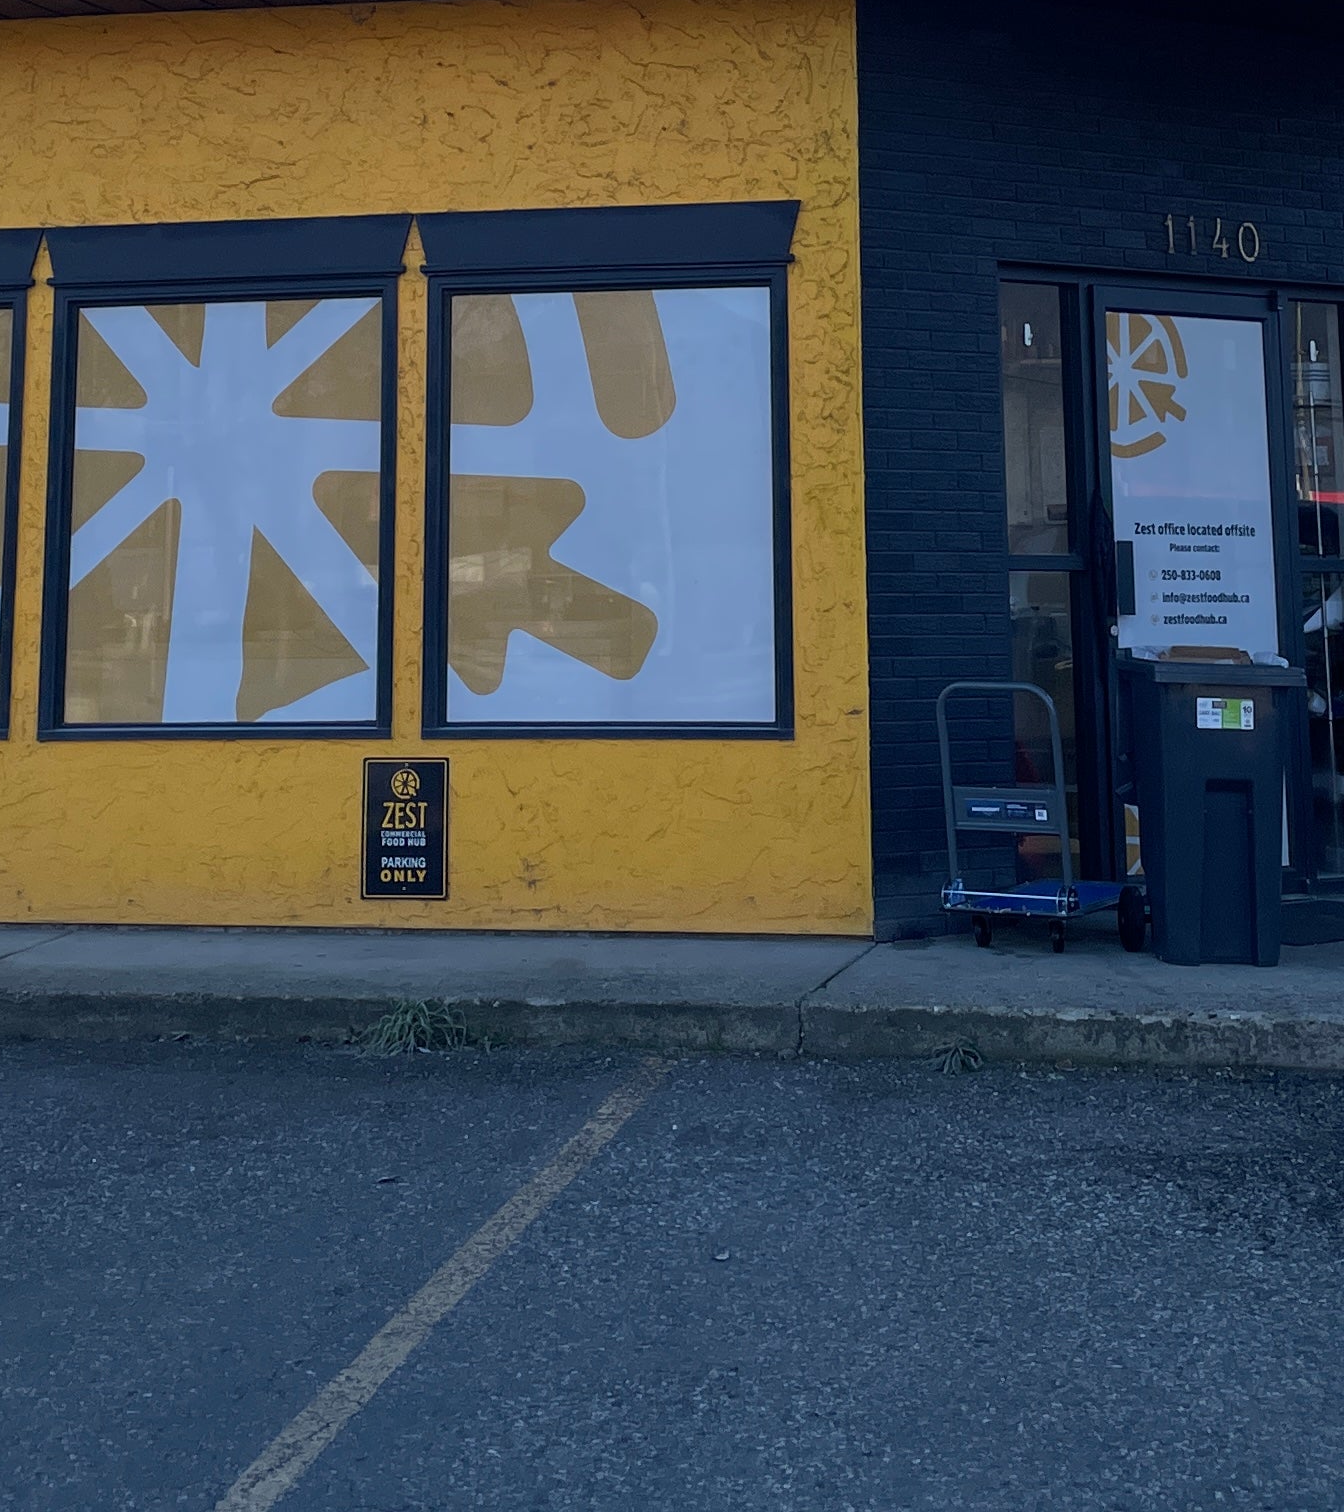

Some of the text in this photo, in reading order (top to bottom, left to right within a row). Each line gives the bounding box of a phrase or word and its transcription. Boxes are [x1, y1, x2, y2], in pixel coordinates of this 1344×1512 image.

[1163, 213, 1261, 264] 1140
[1134, 522, 1256, 537] Zest office located offsite
[1169, 543, 1191, 552] Please
[1163, 613, 1227, 625] zestfoodhub.ca
[381, 801, 428, 829] ZEST
[381, 838, 427, 847] FOOD HUB
[381, 856, 427, 868] PARKING
[380, 869, 427, 883] ONLY
